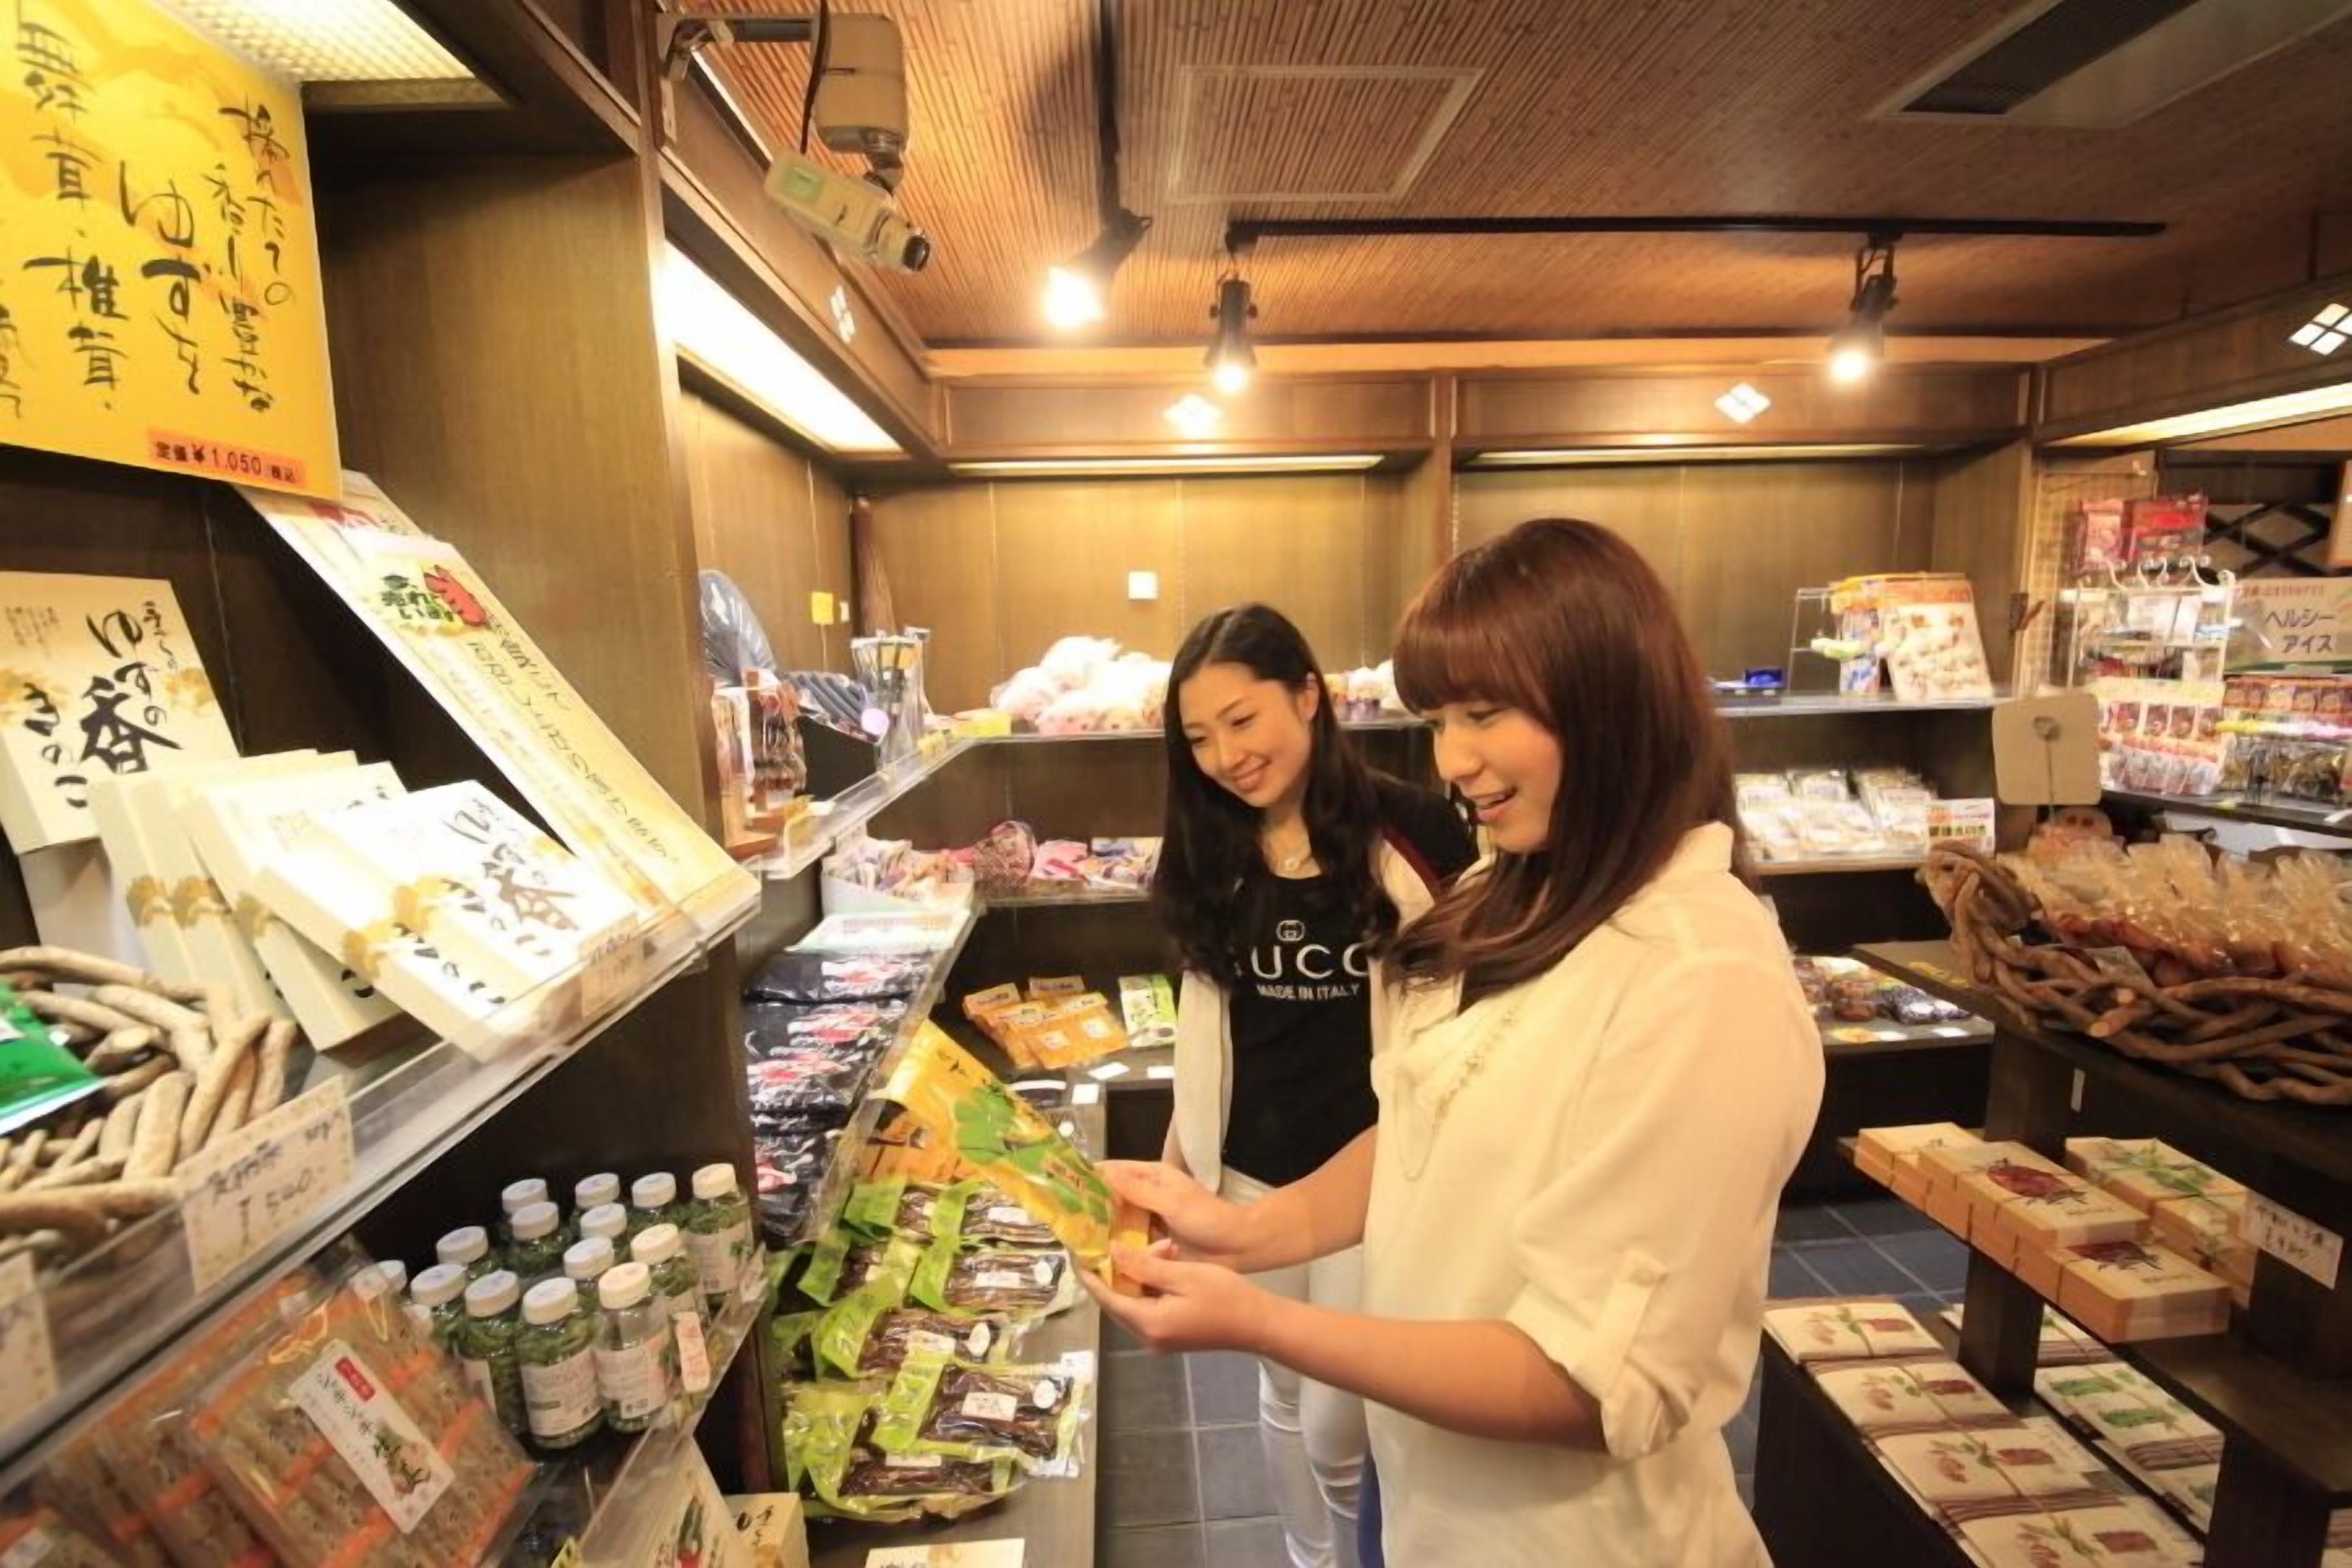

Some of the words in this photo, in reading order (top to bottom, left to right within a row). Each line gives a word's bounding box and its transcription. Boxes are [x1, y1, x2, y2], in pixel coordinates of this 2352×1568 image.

[2266, 608, 2336, 628] ヘルシー
[2283, 634, 2332, 653] アイス
[1256, 984, 1296, 1000] MADE
[1298, 985, 1314, 1000] IN
[1316, 983, 1360, 1000] ITALY
